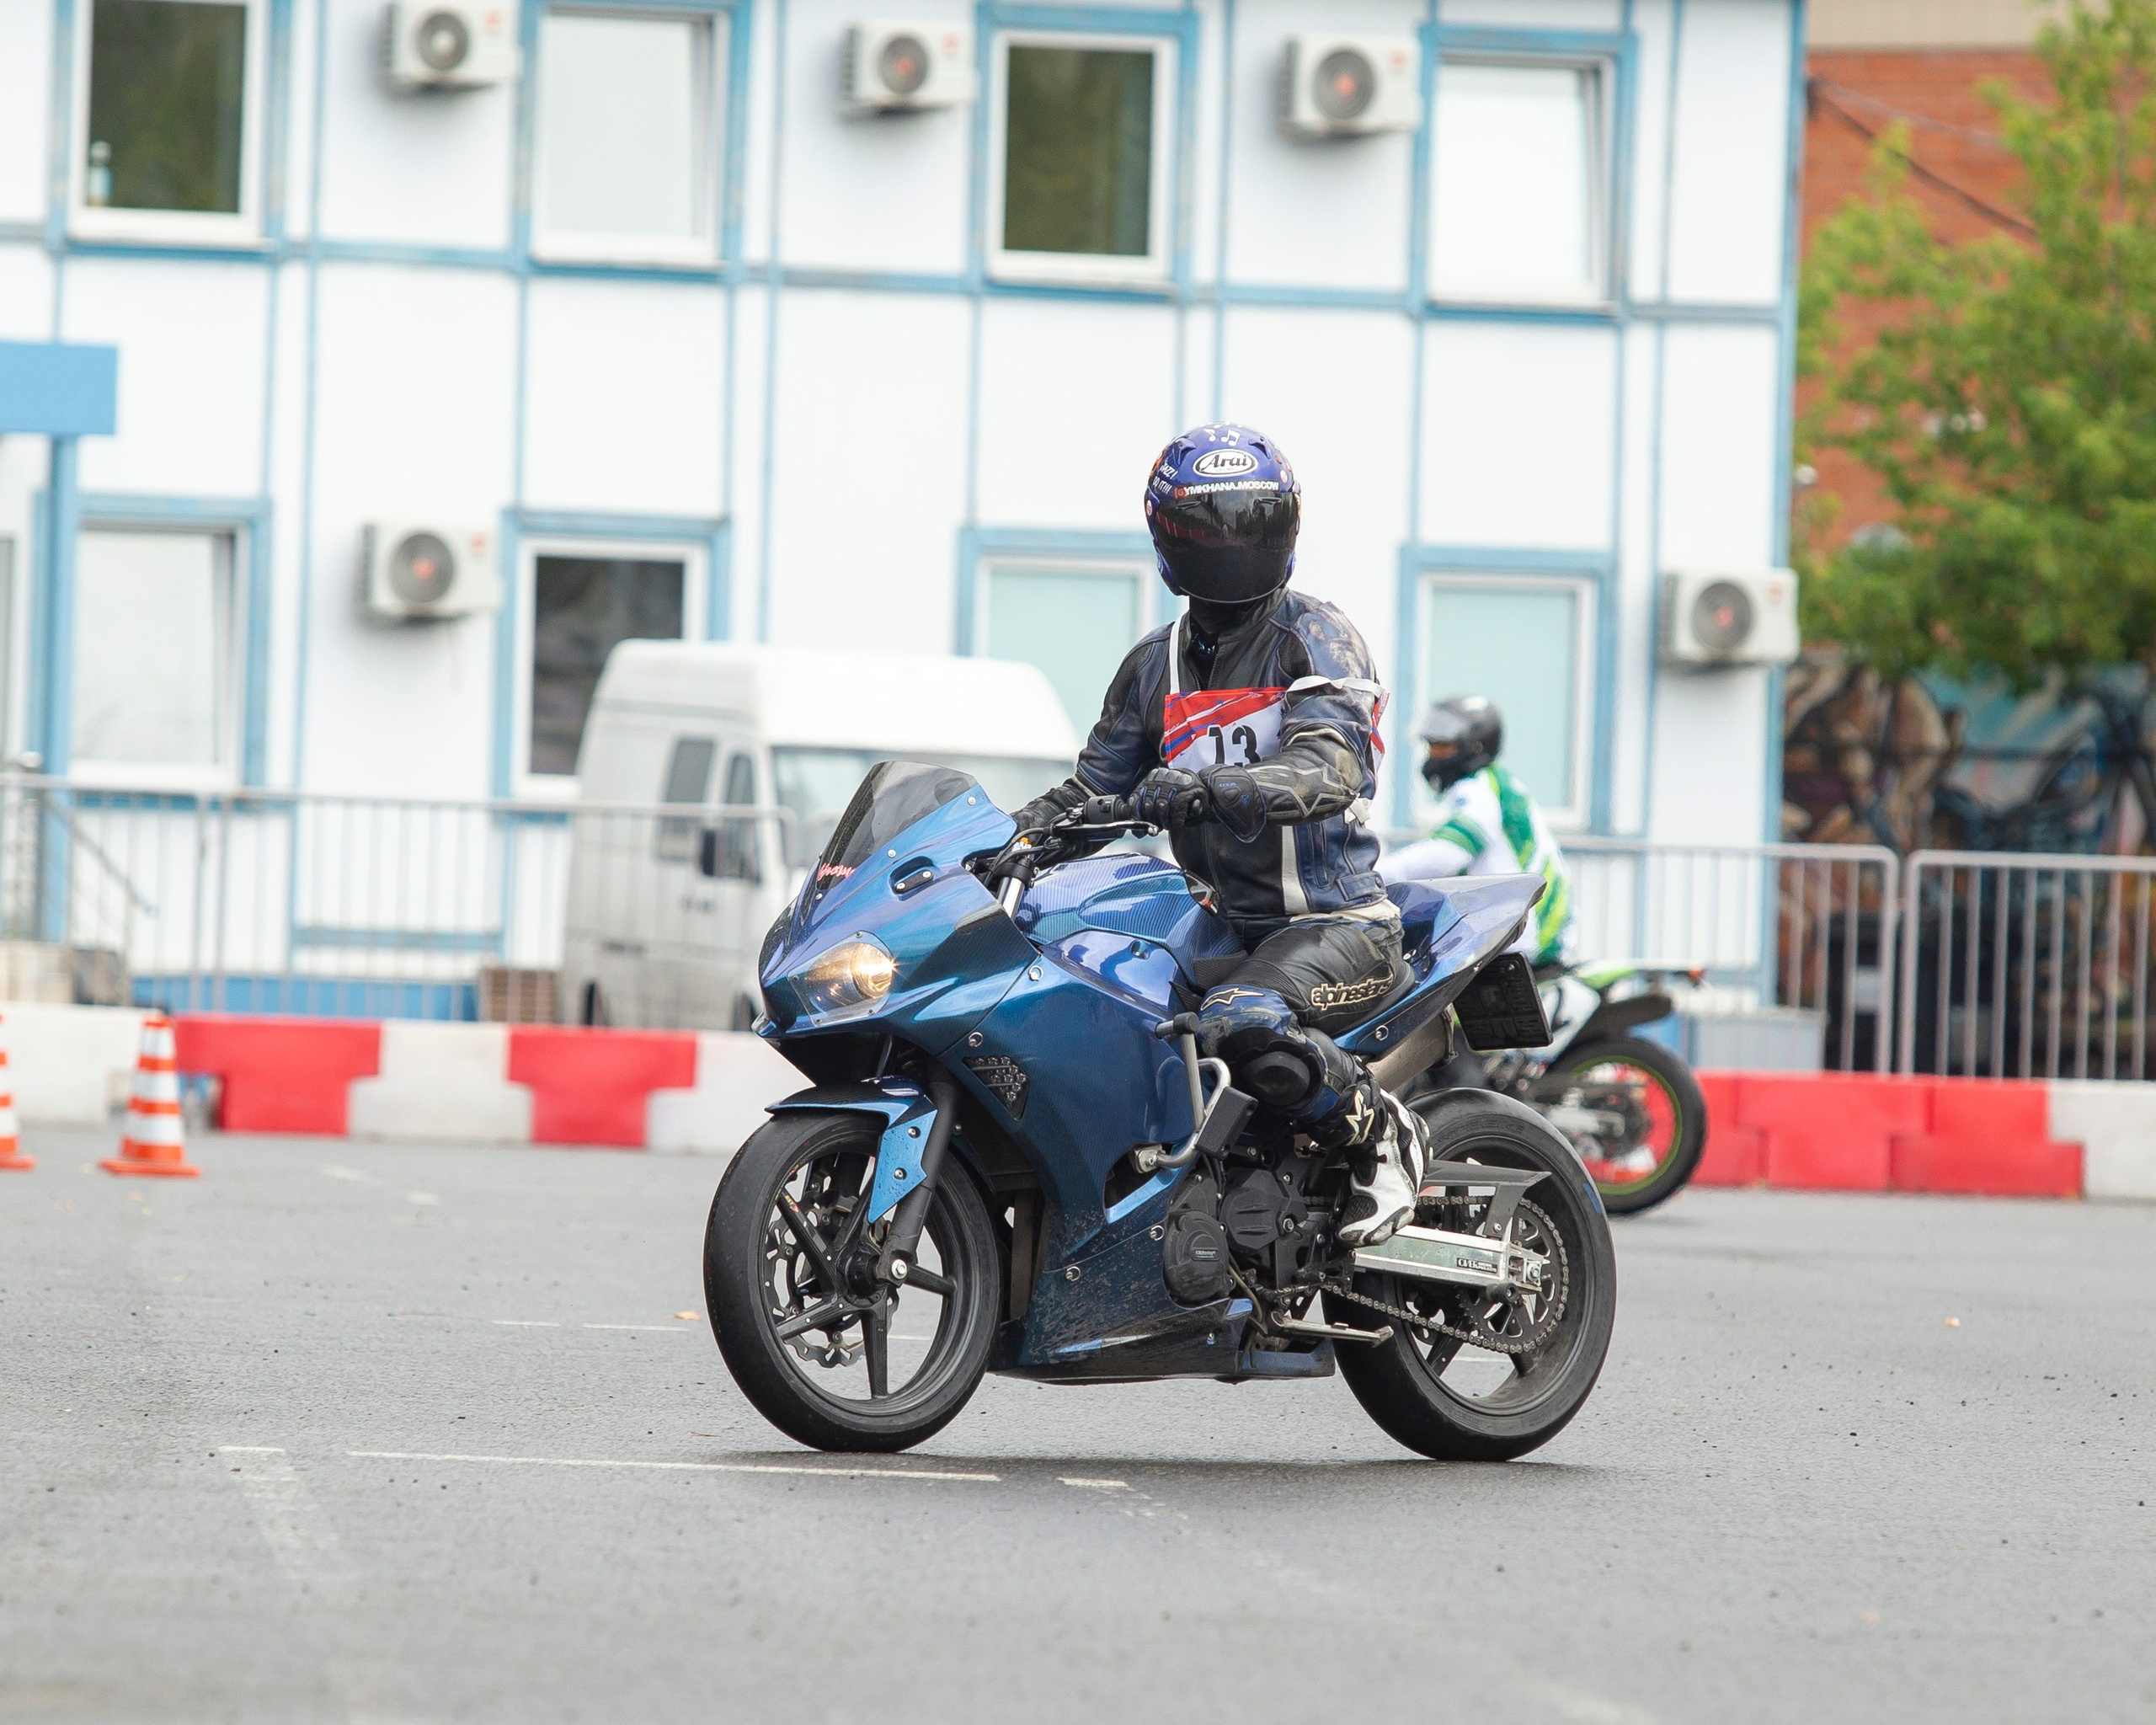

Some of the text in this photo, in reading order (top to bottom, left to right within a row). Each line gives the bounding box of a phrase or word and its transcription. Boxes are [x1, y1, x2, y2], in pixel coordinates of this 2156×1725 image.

[1201, 455, 1247, 471] Arai
[1209, 724, 1262, 767] 13
[1311, 974, 1394, 1011] alpinestars
